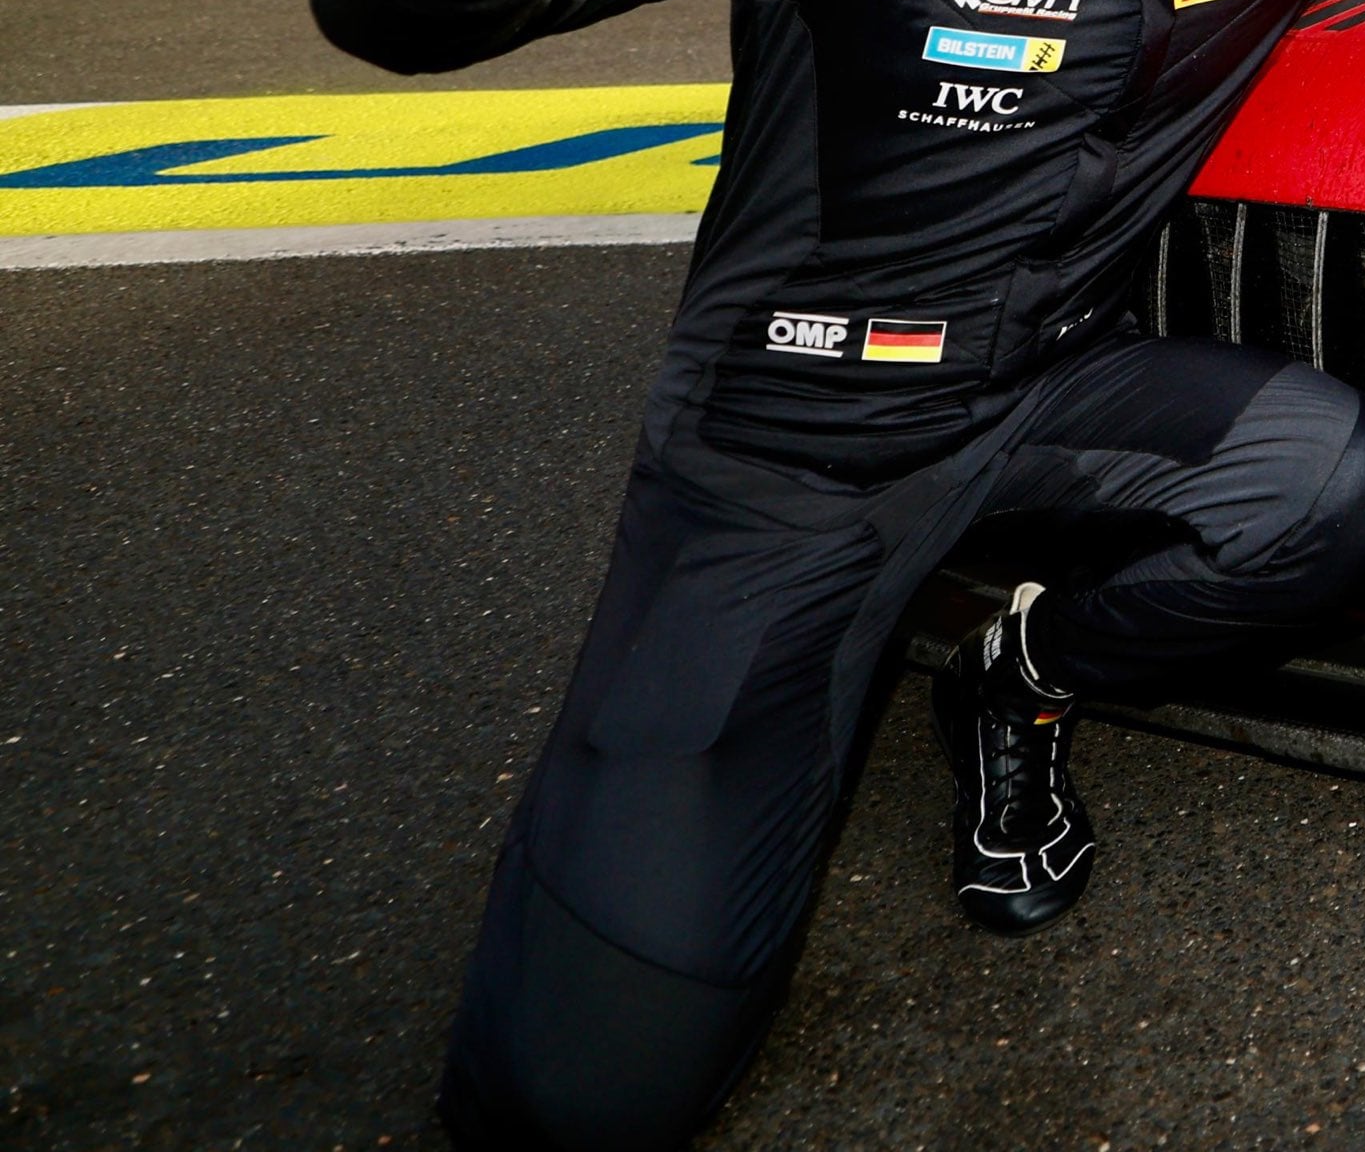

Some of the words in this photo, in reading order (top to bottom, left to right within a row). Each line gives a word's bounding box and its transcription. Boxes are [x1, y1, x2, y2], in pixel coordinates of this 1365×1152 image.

[937, 37, 1017, 61] BILSTEIN
[932, 81, 1024, 115] IWC
[767, 318, 848, 349] OMP
